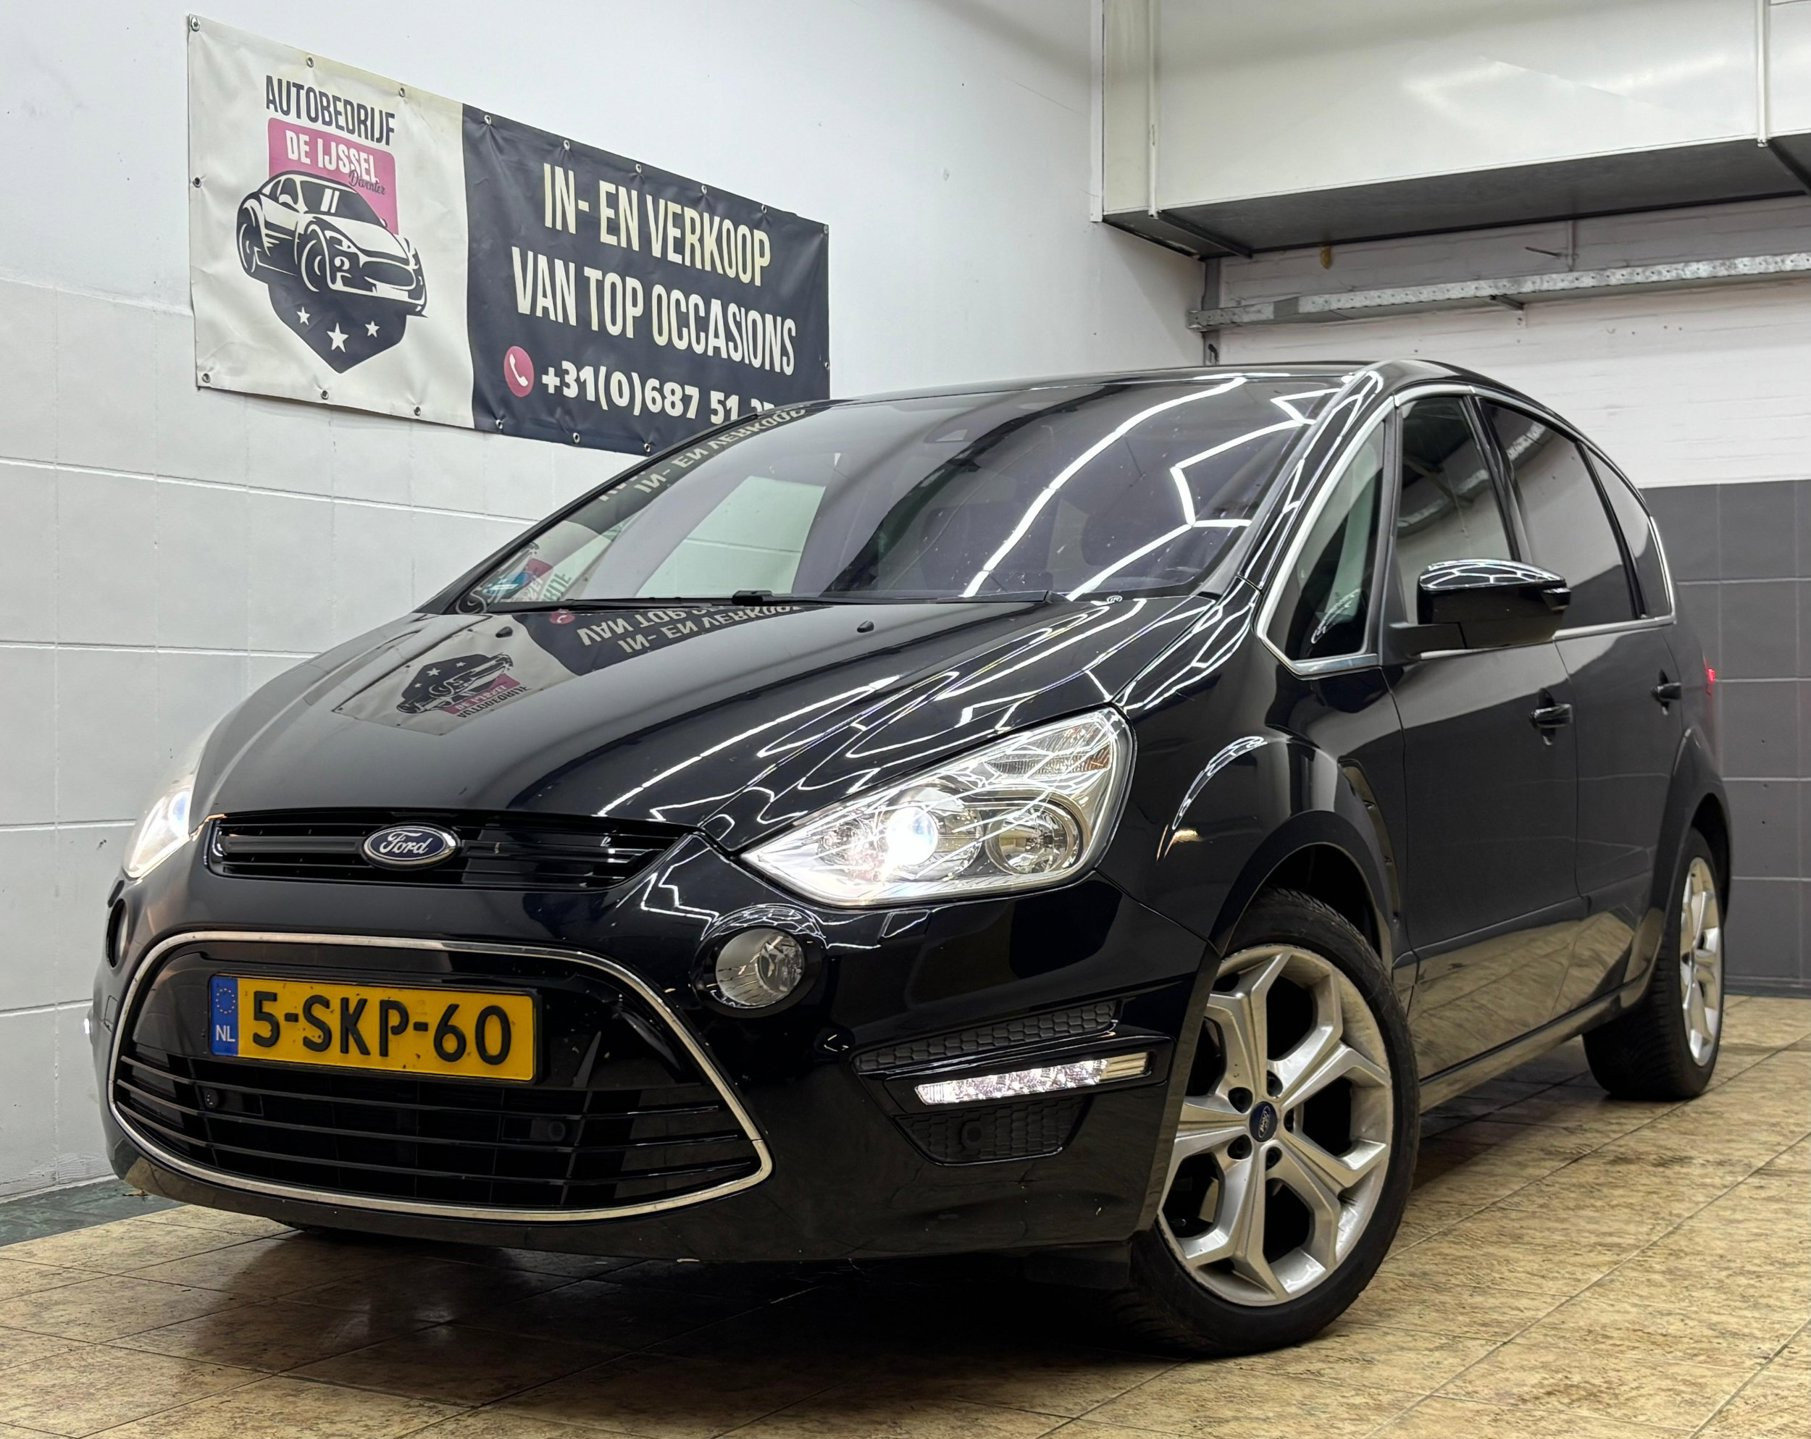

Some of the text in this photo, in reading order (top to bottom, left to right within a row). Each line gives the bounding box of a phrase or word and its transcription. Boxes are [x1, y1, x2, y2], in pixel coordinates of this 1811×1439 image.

[266, 75, 395, 146] AUTOBEDRIJF
[285, 129, 380, 183] DE IJSSEL
[543, 163, 771, 287] IN- EN VERKOOP
[511, 246, 796, 376] VAN TOP OCCASIONS
[541, 360, 740, 425] +31(0)687 51
[379, 831, 434, 854] Ford
[215, 1024, 235, 1043] NL
[252, 990, 512, 1066] 5-SKP-60
